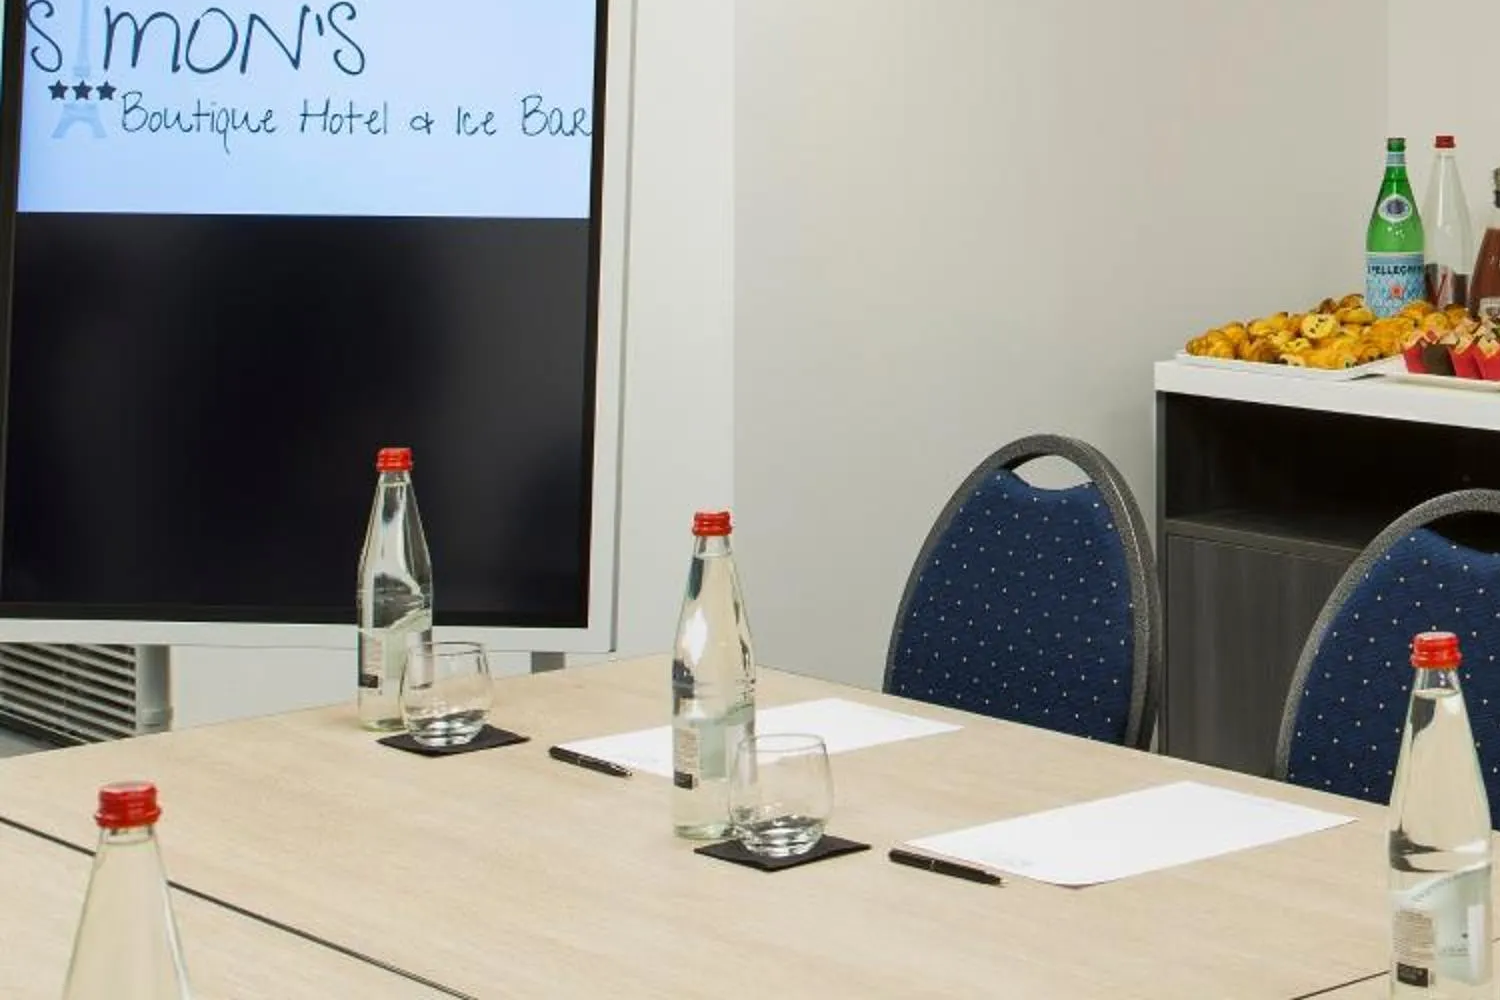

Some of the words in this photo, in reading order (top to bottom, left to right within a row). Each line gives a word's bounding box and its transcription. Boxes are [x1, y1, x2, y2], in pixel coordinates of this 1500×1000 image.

[121, 90, 279, 155] Boutique
[299, 96, 389, 135] Hotel
[455, 105, 497, 136] Ice
